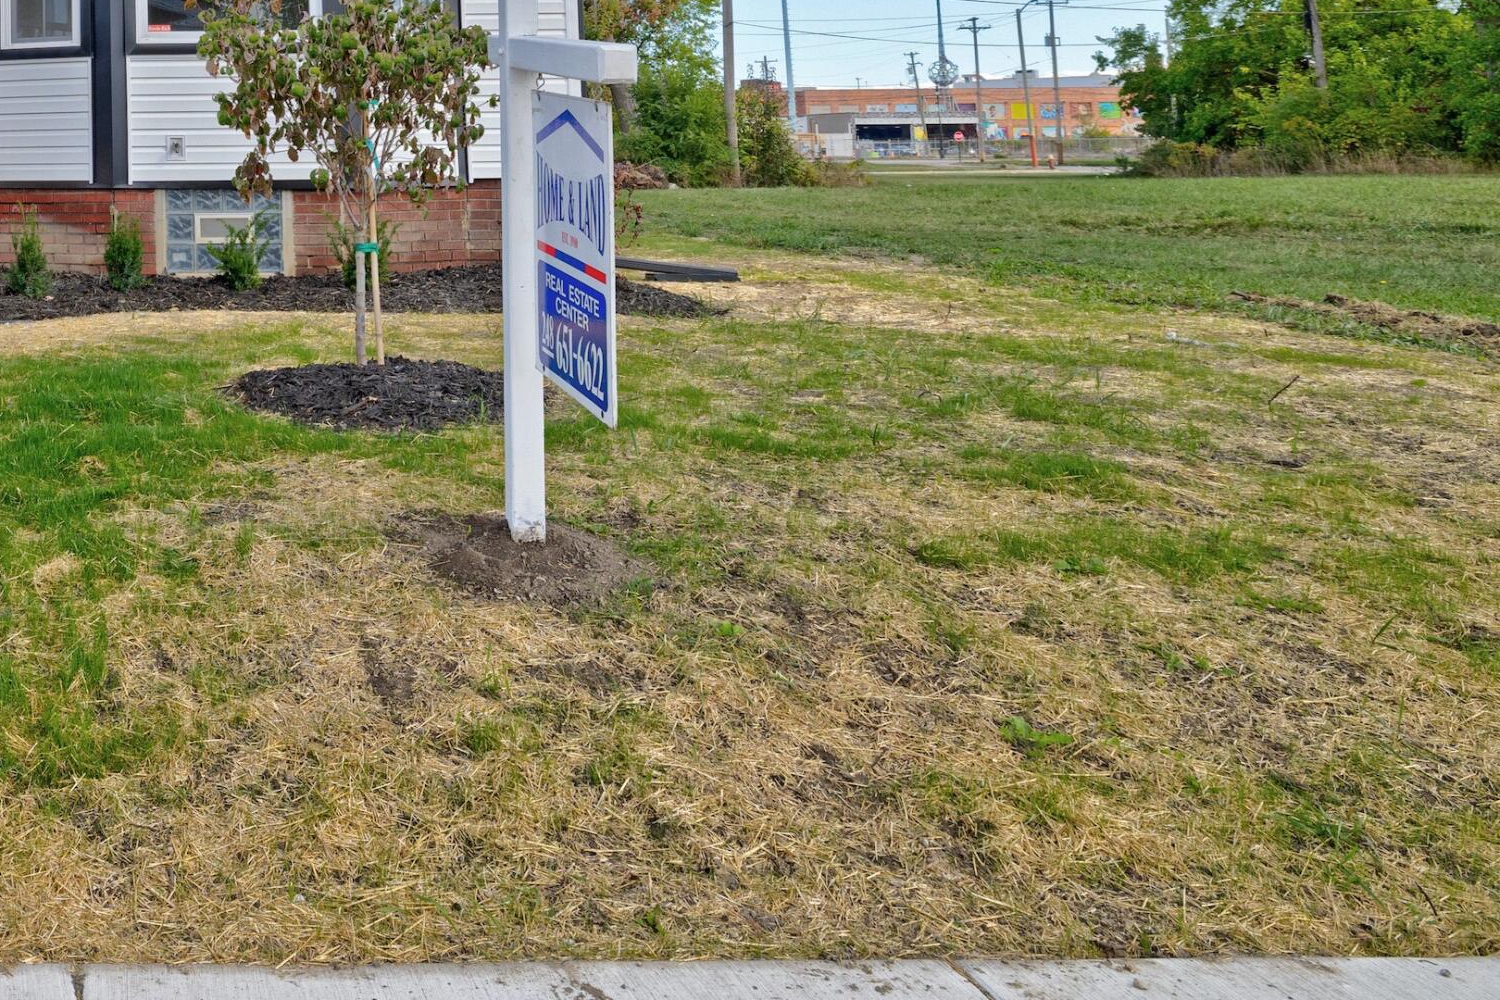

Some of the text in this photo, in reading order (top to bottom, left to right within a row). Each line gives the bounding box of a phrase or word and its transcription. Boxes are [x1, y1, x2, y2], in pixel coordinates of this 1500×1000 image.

[536, 150, 606, 257] HOME & LAND
[545, 271, 600, 318] REAL ESTATE
[555, 297, 590, 332] CENTER
[541, 311, 604, 402] 248 651-6622
